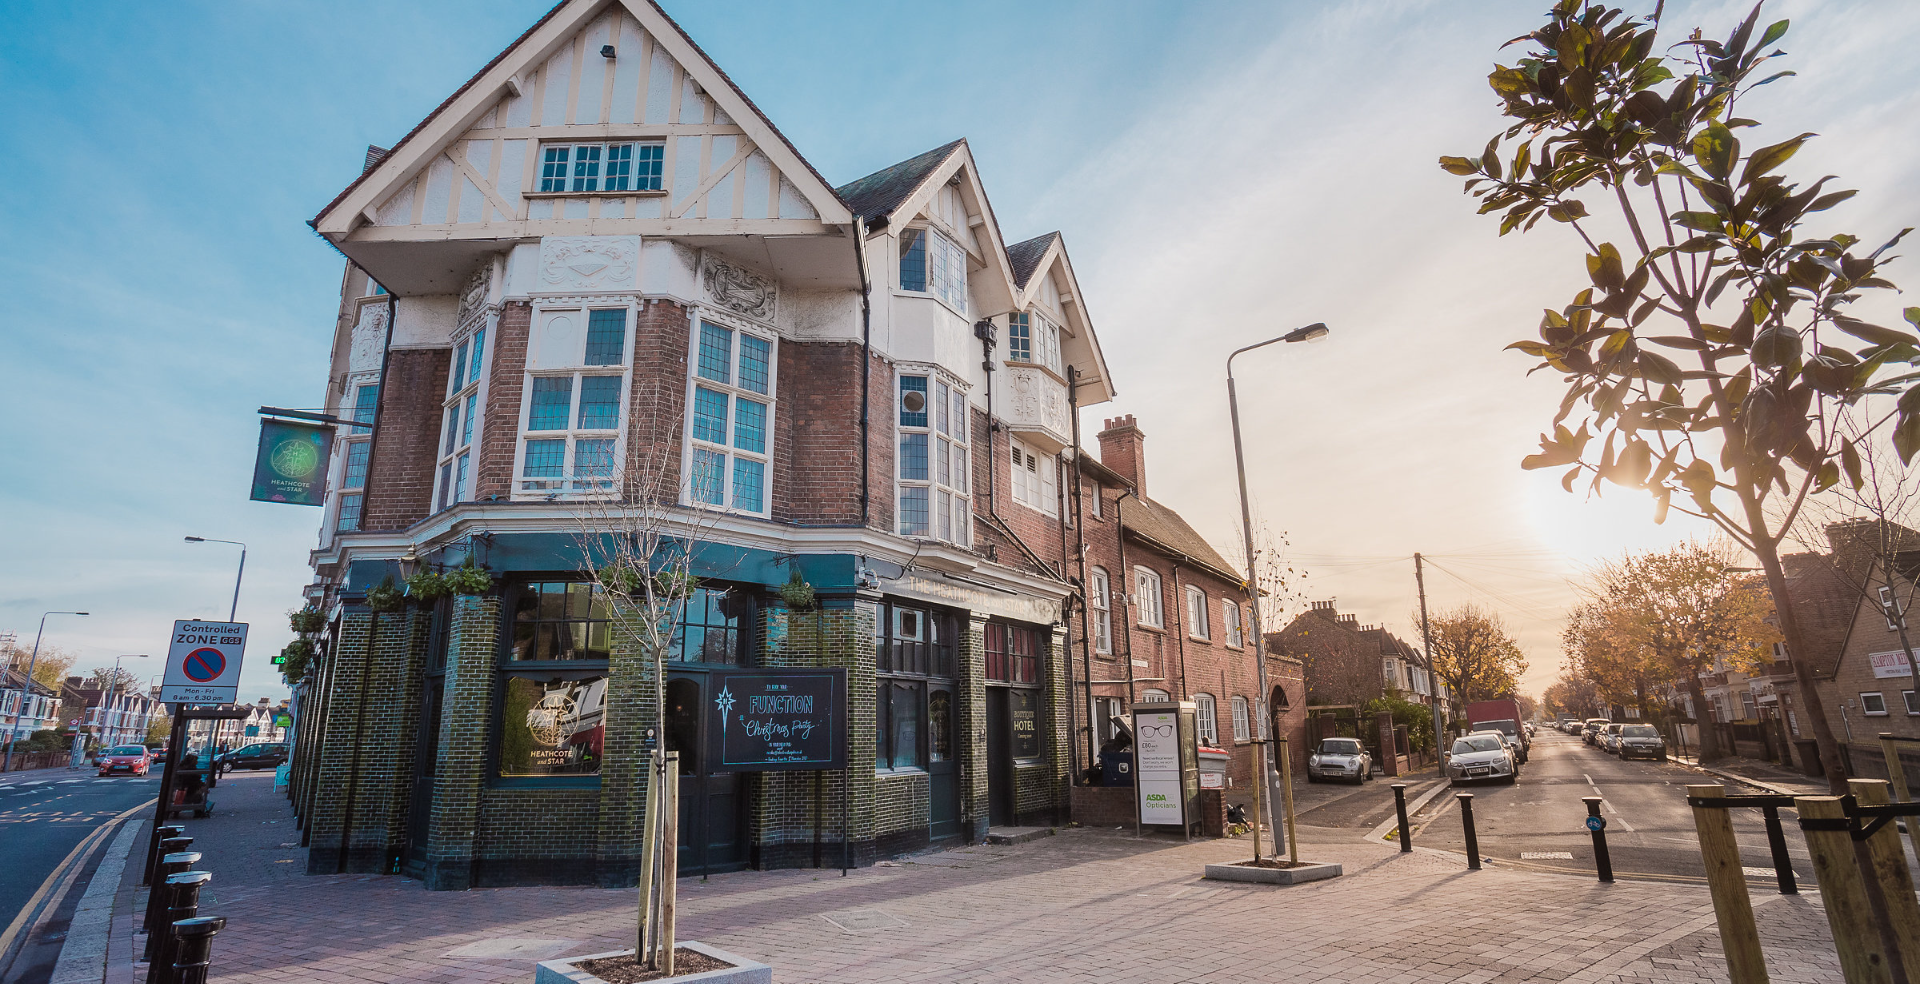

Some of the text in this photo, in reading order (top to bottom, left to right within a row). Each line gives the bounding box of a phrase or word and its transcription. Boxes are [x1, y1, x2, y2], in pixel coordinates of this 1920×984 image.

[271, 480, 310, 488] HEATHCOTE
[909, 576, 930, 594] THE
[933, 581, 988, 607] HEATHCOTE
[1005, 599, 1025, 614] STAR
[183, 624, 240, 634] Controlled
[176, 634, 218, 644] ZONE
[749, 695, 813, 714] FUNCTION
[746, 717, 815, 741] Christmas Party
[1014, 720, 1035, 730] HOTEL
[530, 750, 573, 758] HEATHCOTE
[1146, 801, 1177, 810] Opticians
